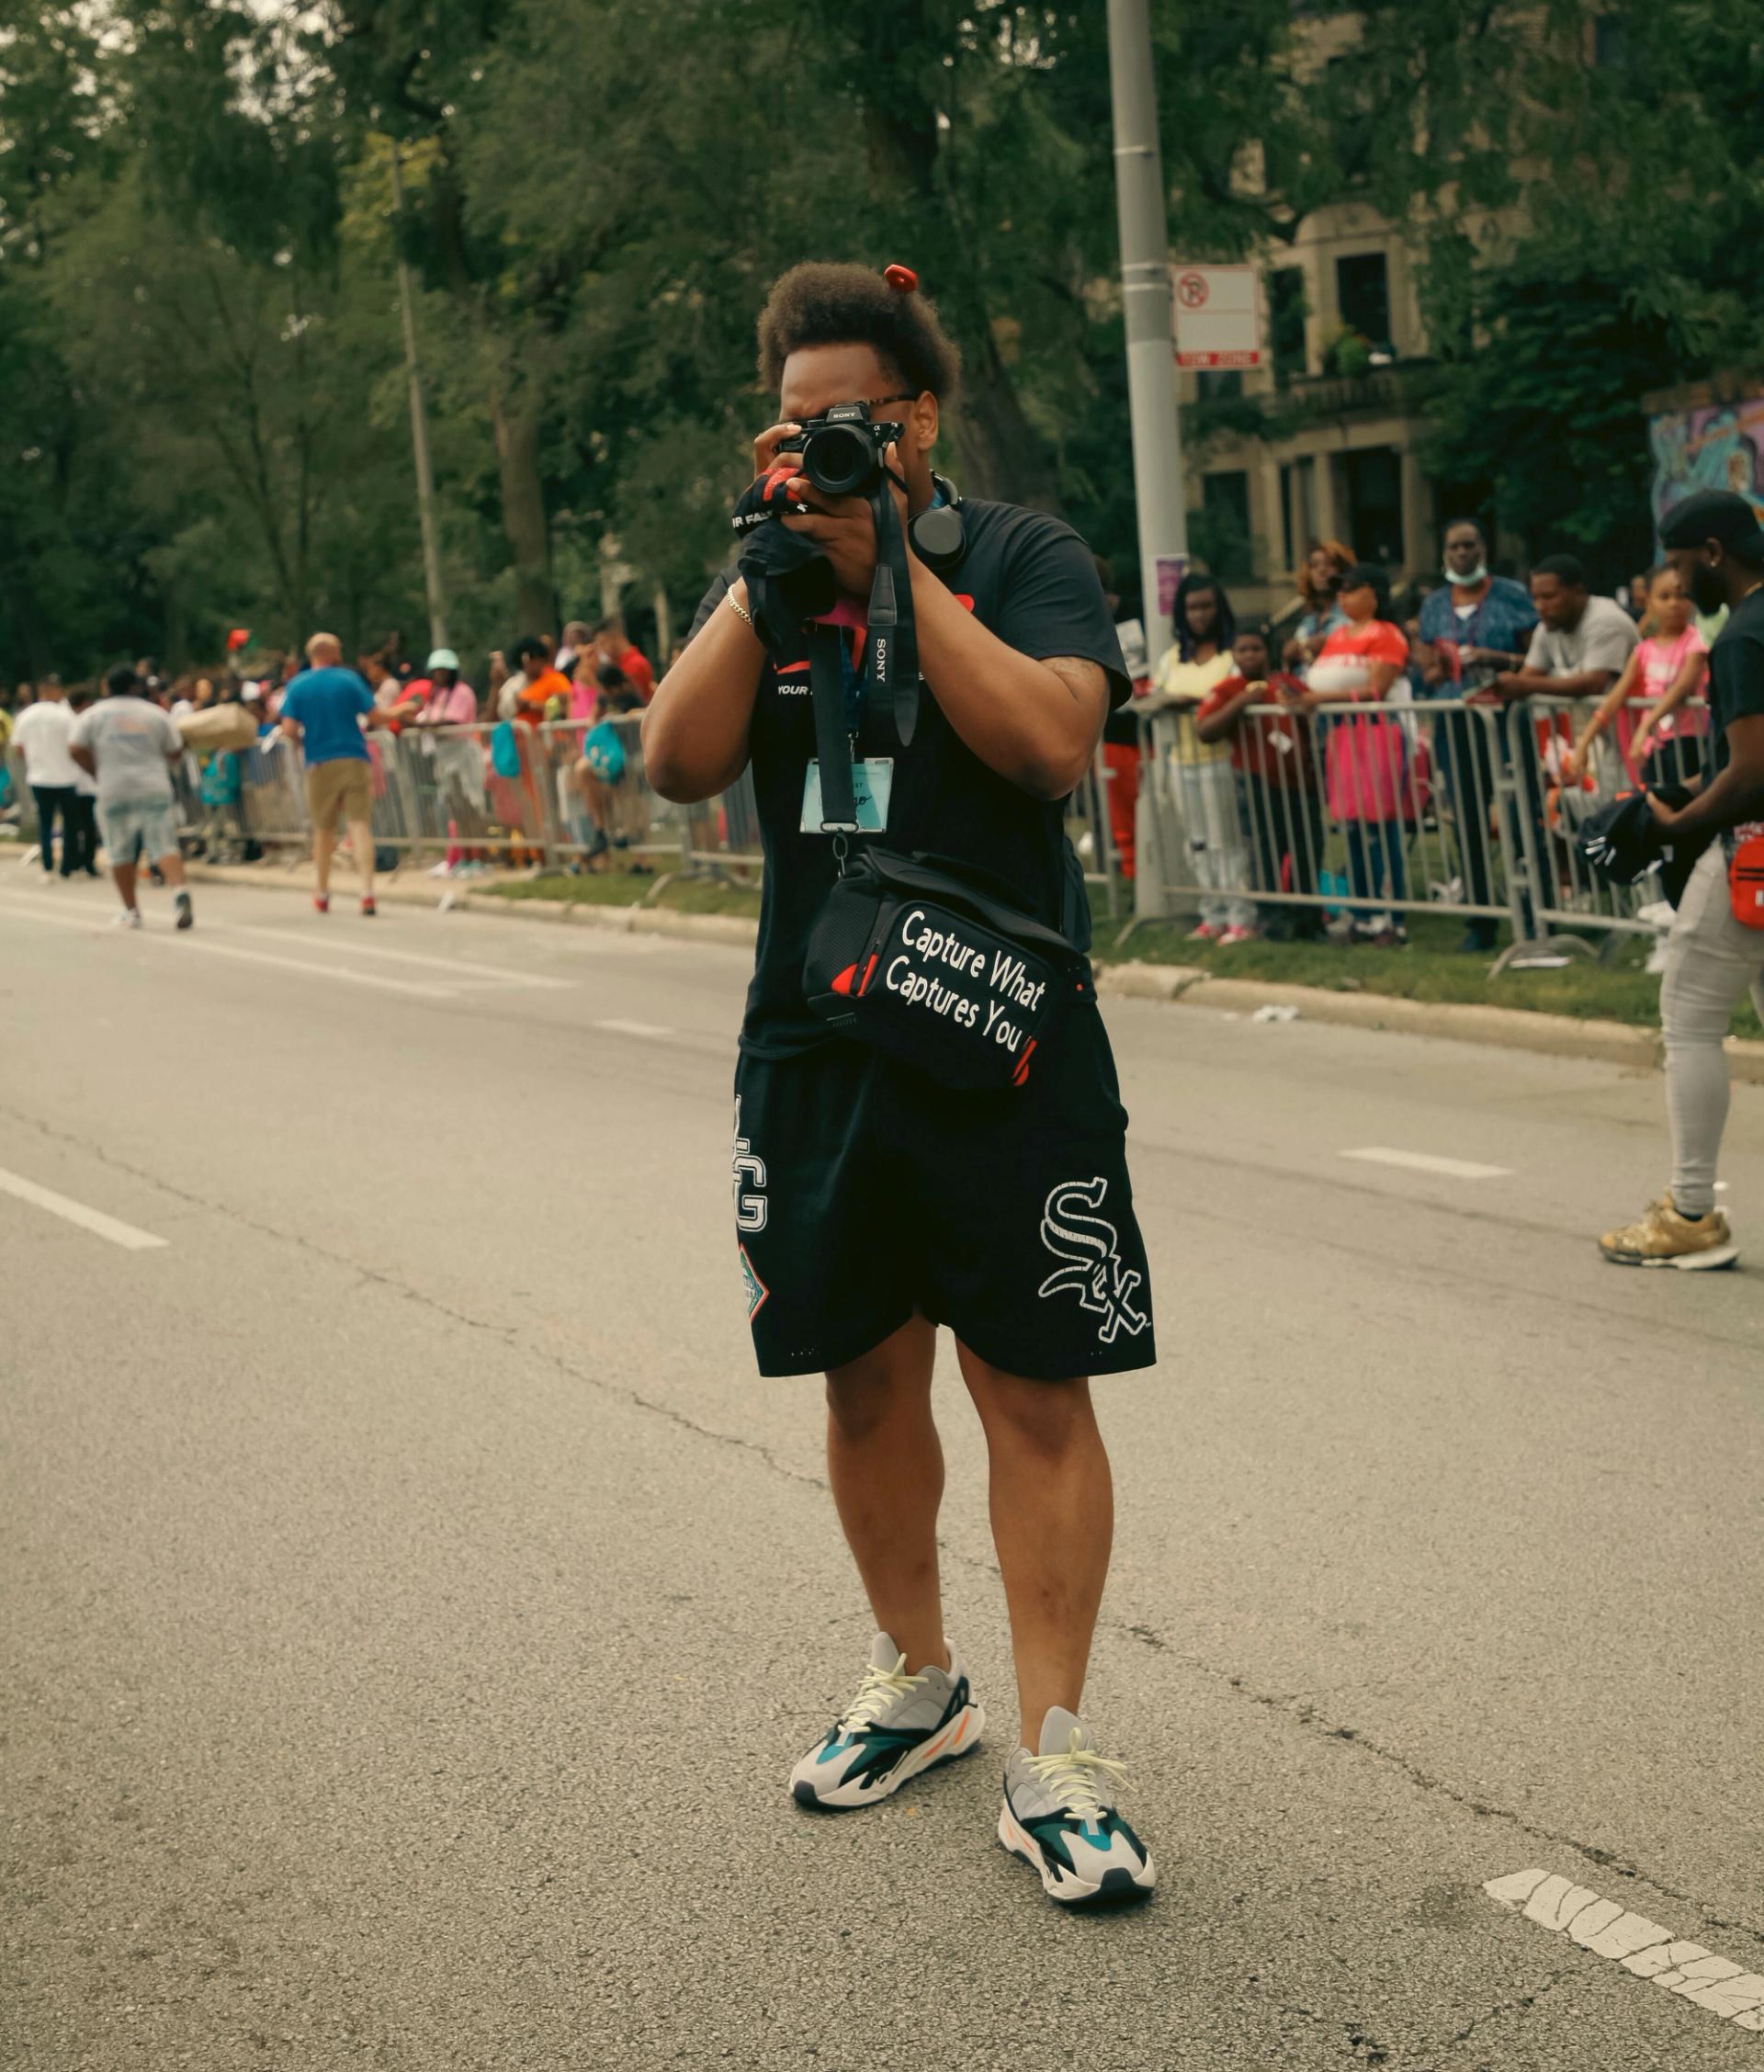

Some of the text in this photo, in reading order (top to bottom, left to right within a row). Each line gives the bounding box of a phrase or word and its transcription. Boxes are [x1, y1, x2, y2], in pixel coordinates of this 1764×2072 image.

[777, 685, 808, 696] YOUR
[876, 639, 886, 682] SONY
[902, 911, 1046, 1012] Capture What
[886, 955, 1023, 1053] Captures You
